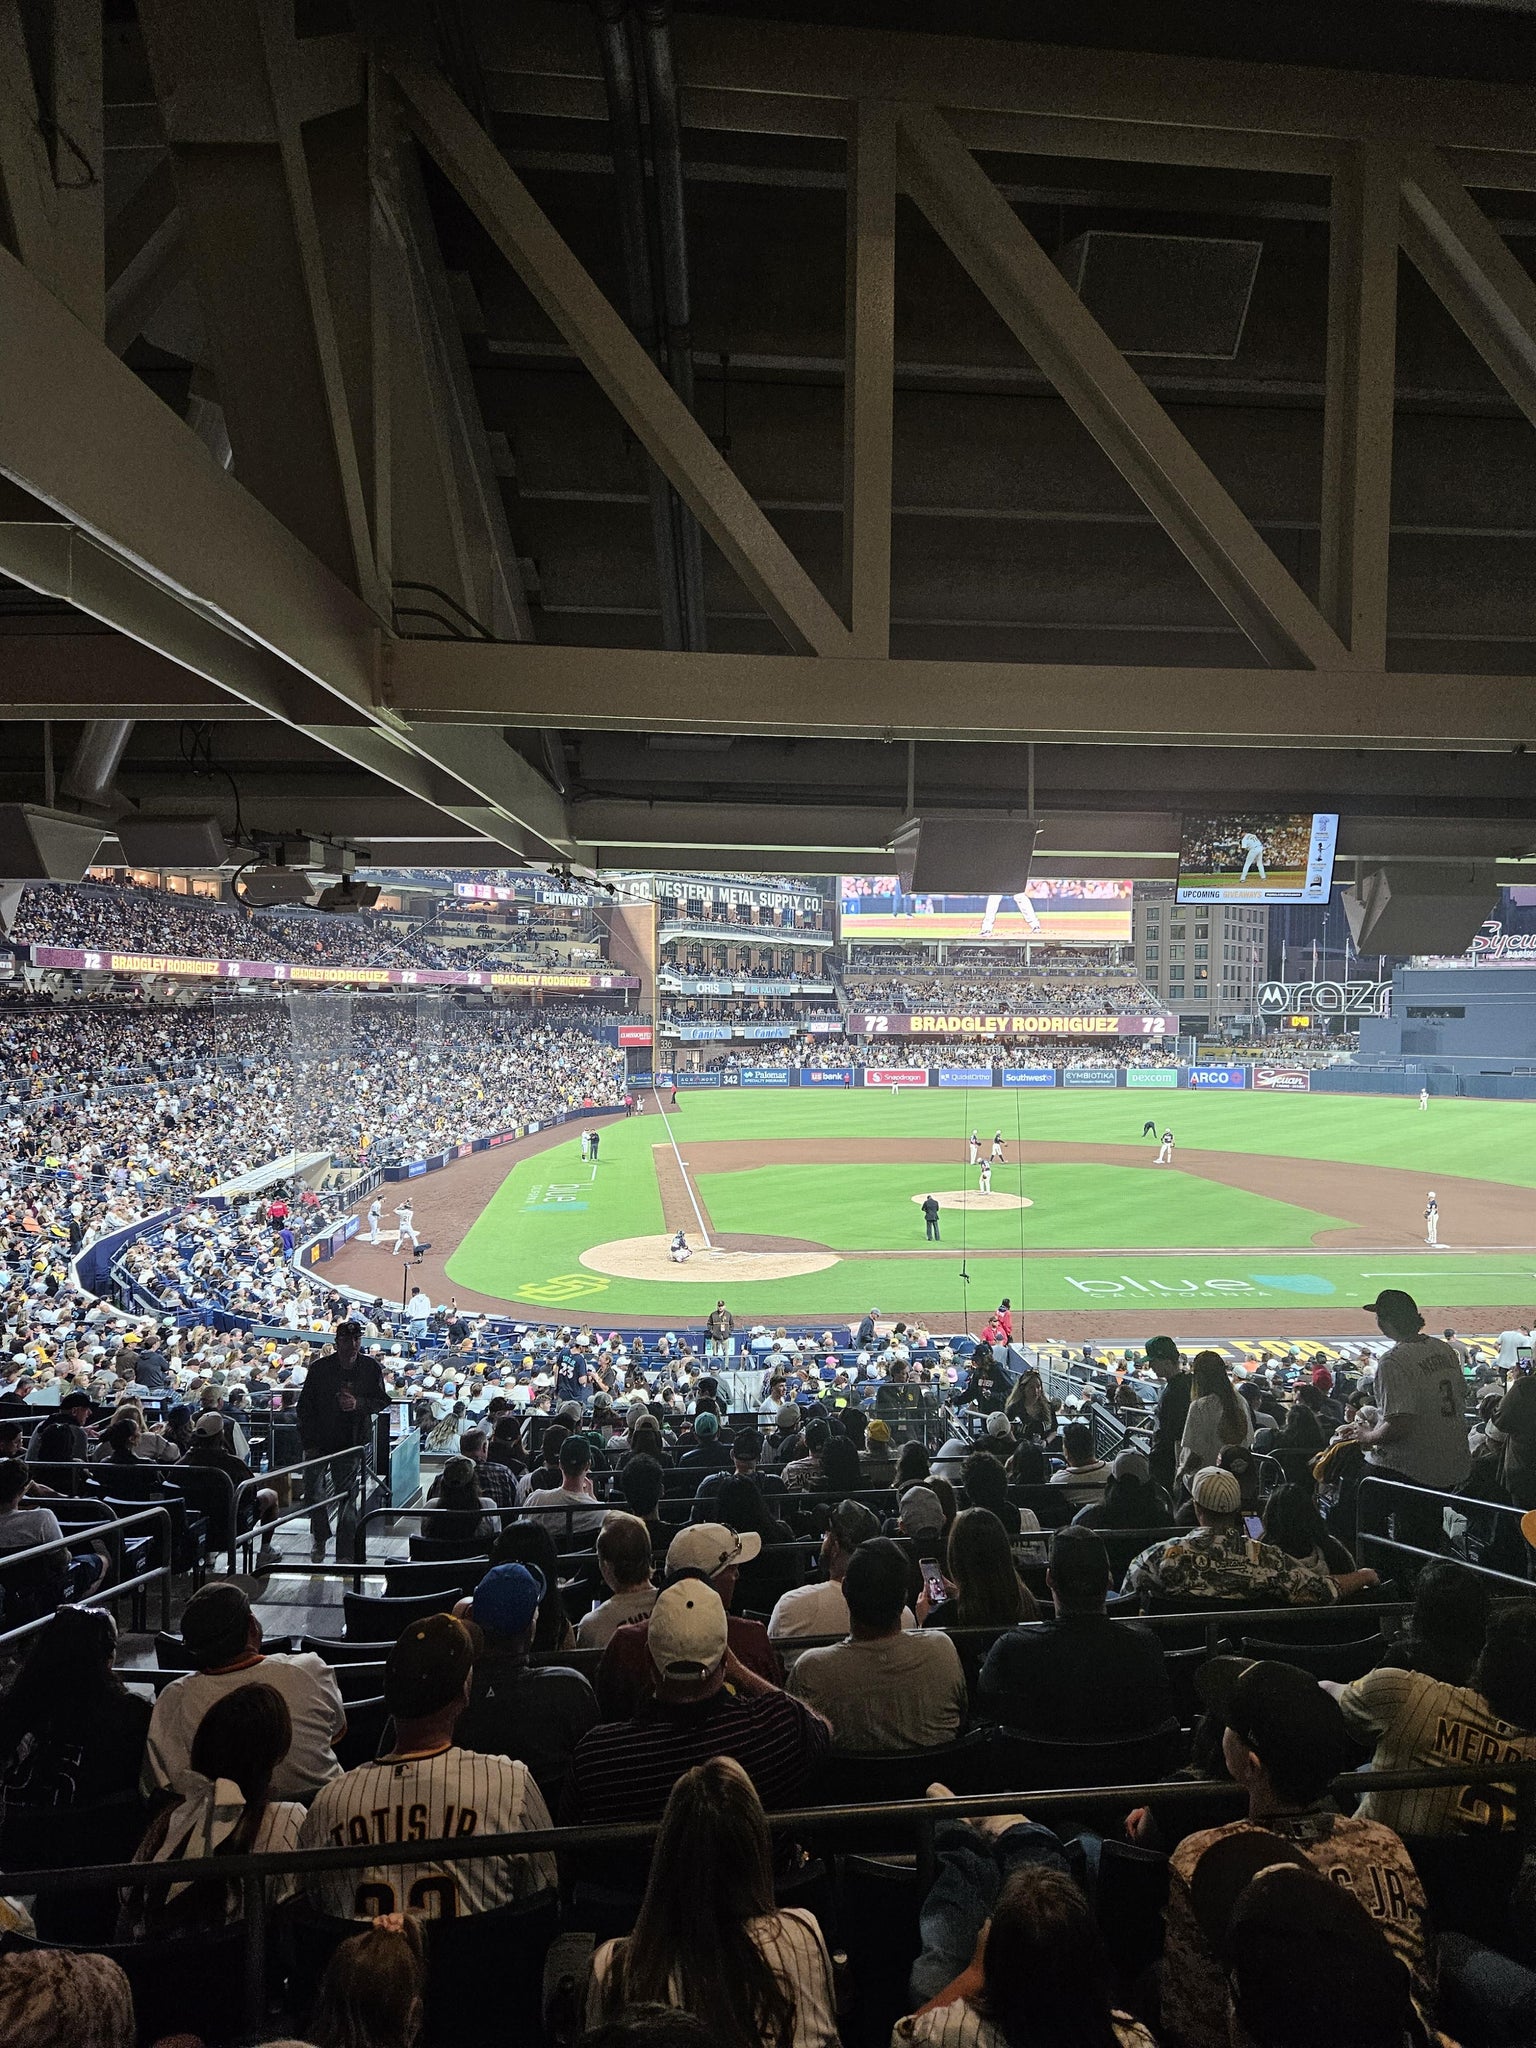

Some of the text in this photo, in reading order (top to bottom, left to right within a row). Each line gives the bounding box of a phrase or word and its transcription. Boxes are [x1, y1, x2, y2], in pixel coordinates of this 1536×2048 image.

[655, 880, 822, 912] WESTERN METAL SUPPLY CO.
[1183, 890, 1220, 898] UPCOMING
[84, 953, 240, 976] 72 BRADGLEY RODRIGUEZ 72
[324, 969, 389, 982] RODRIGUEZ
[491, 973, 541, 985] BRADGLEY
[541, 975, 591, 987] RODRIGUEZ
[696, 983, 720, 994] ORIS
[864, 1016, 1165, 1032] 72 BRADGLEY RODRIGUEZ 72
[660, 1040, 672, 1049] 336
[723, 1075, 738, 1085] 342
[755, 1071, 787, 1079] Palomar
[884, 1073, 921, 1081] Snapdragon
[1006, 1073, 1047, 1082] Southwest
[1066, 1072, 1115, 1080] CYMBIOTIKA
[1190, 1072, 1229, 1083] ARCO
[1257, 1071, 1304, 1088] Sycuan
[1064, 1275, 1255, 1293] blue
[1433, 1717, 1536, 1765] MERR
[330, 1804, 428, 1846] TATIS
